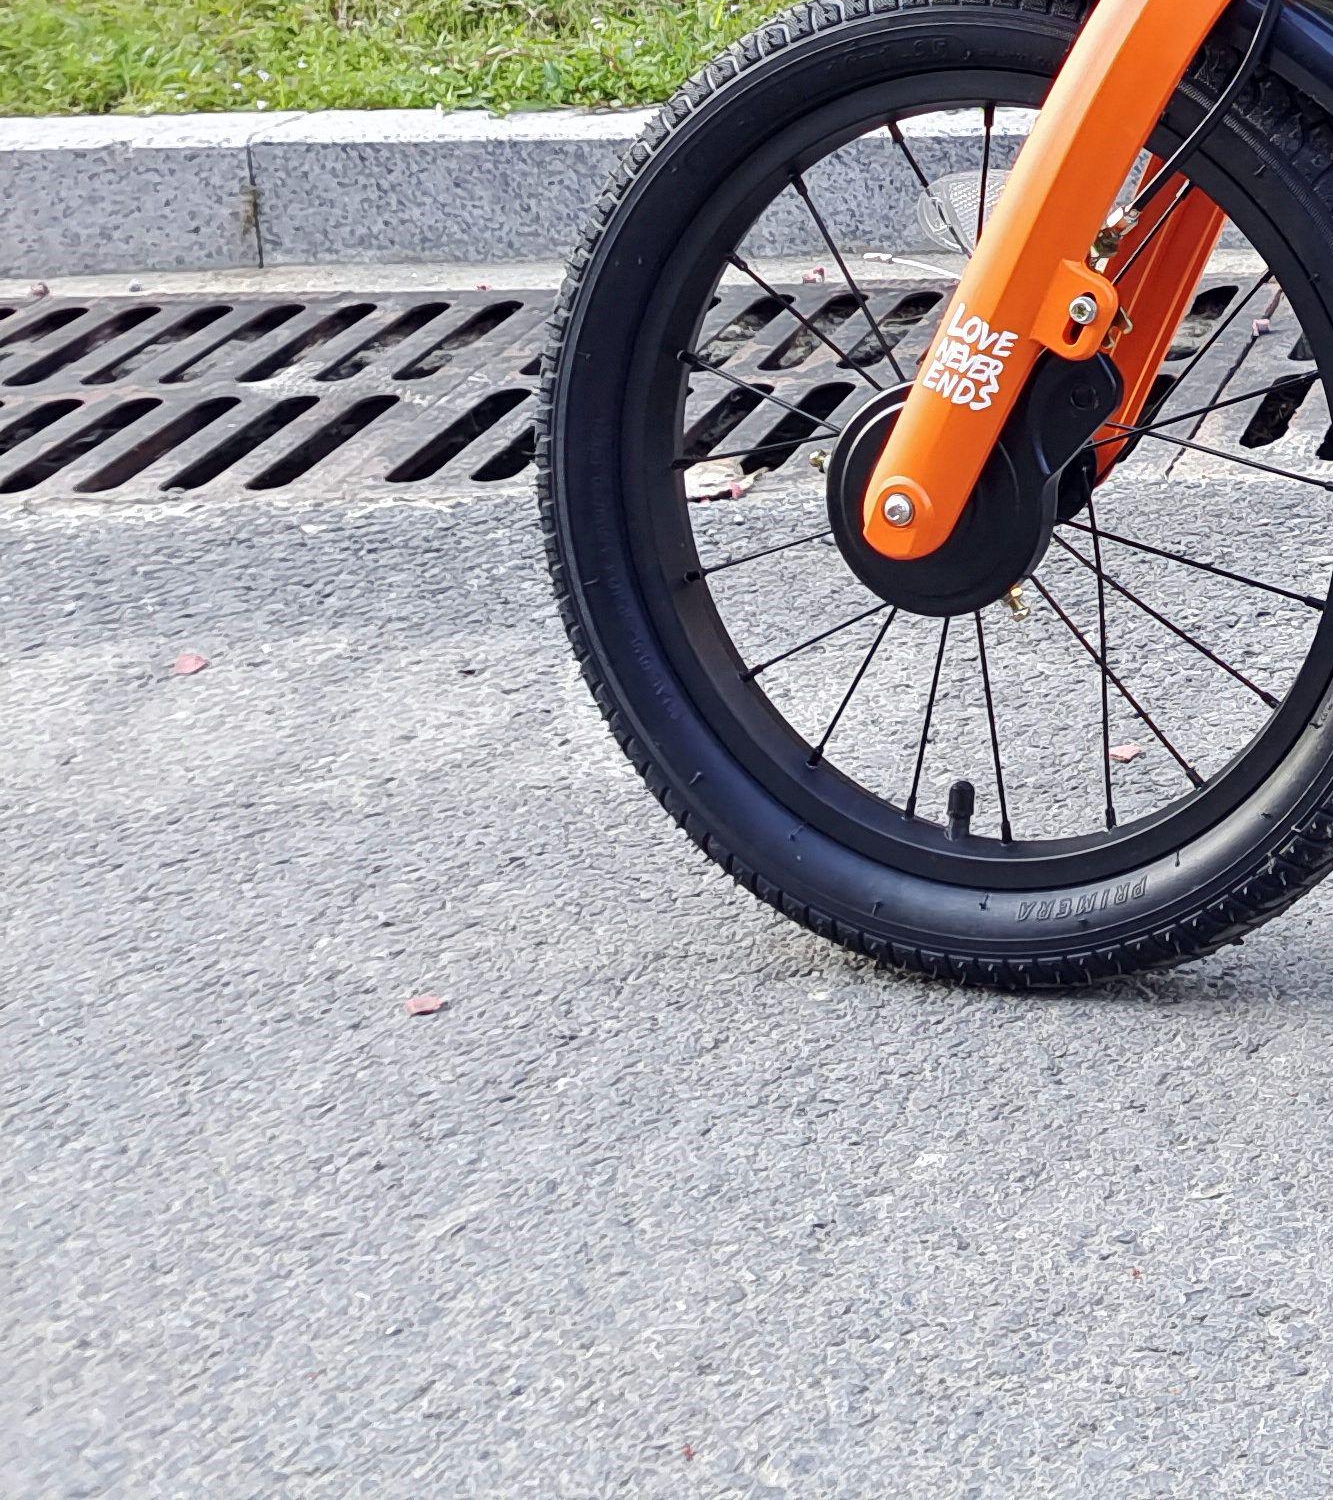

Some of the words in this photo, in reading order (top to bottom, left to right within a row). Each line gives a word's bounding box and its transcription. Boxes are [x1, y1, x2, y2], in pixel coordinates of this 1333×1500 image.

[946, 303, 1019, 357] LOVE
[923, 361, 1000, 411] ENDS
[935, 337, 1004, 392] NEVER
[1015, 874, 1150, 924] PRIMERA
